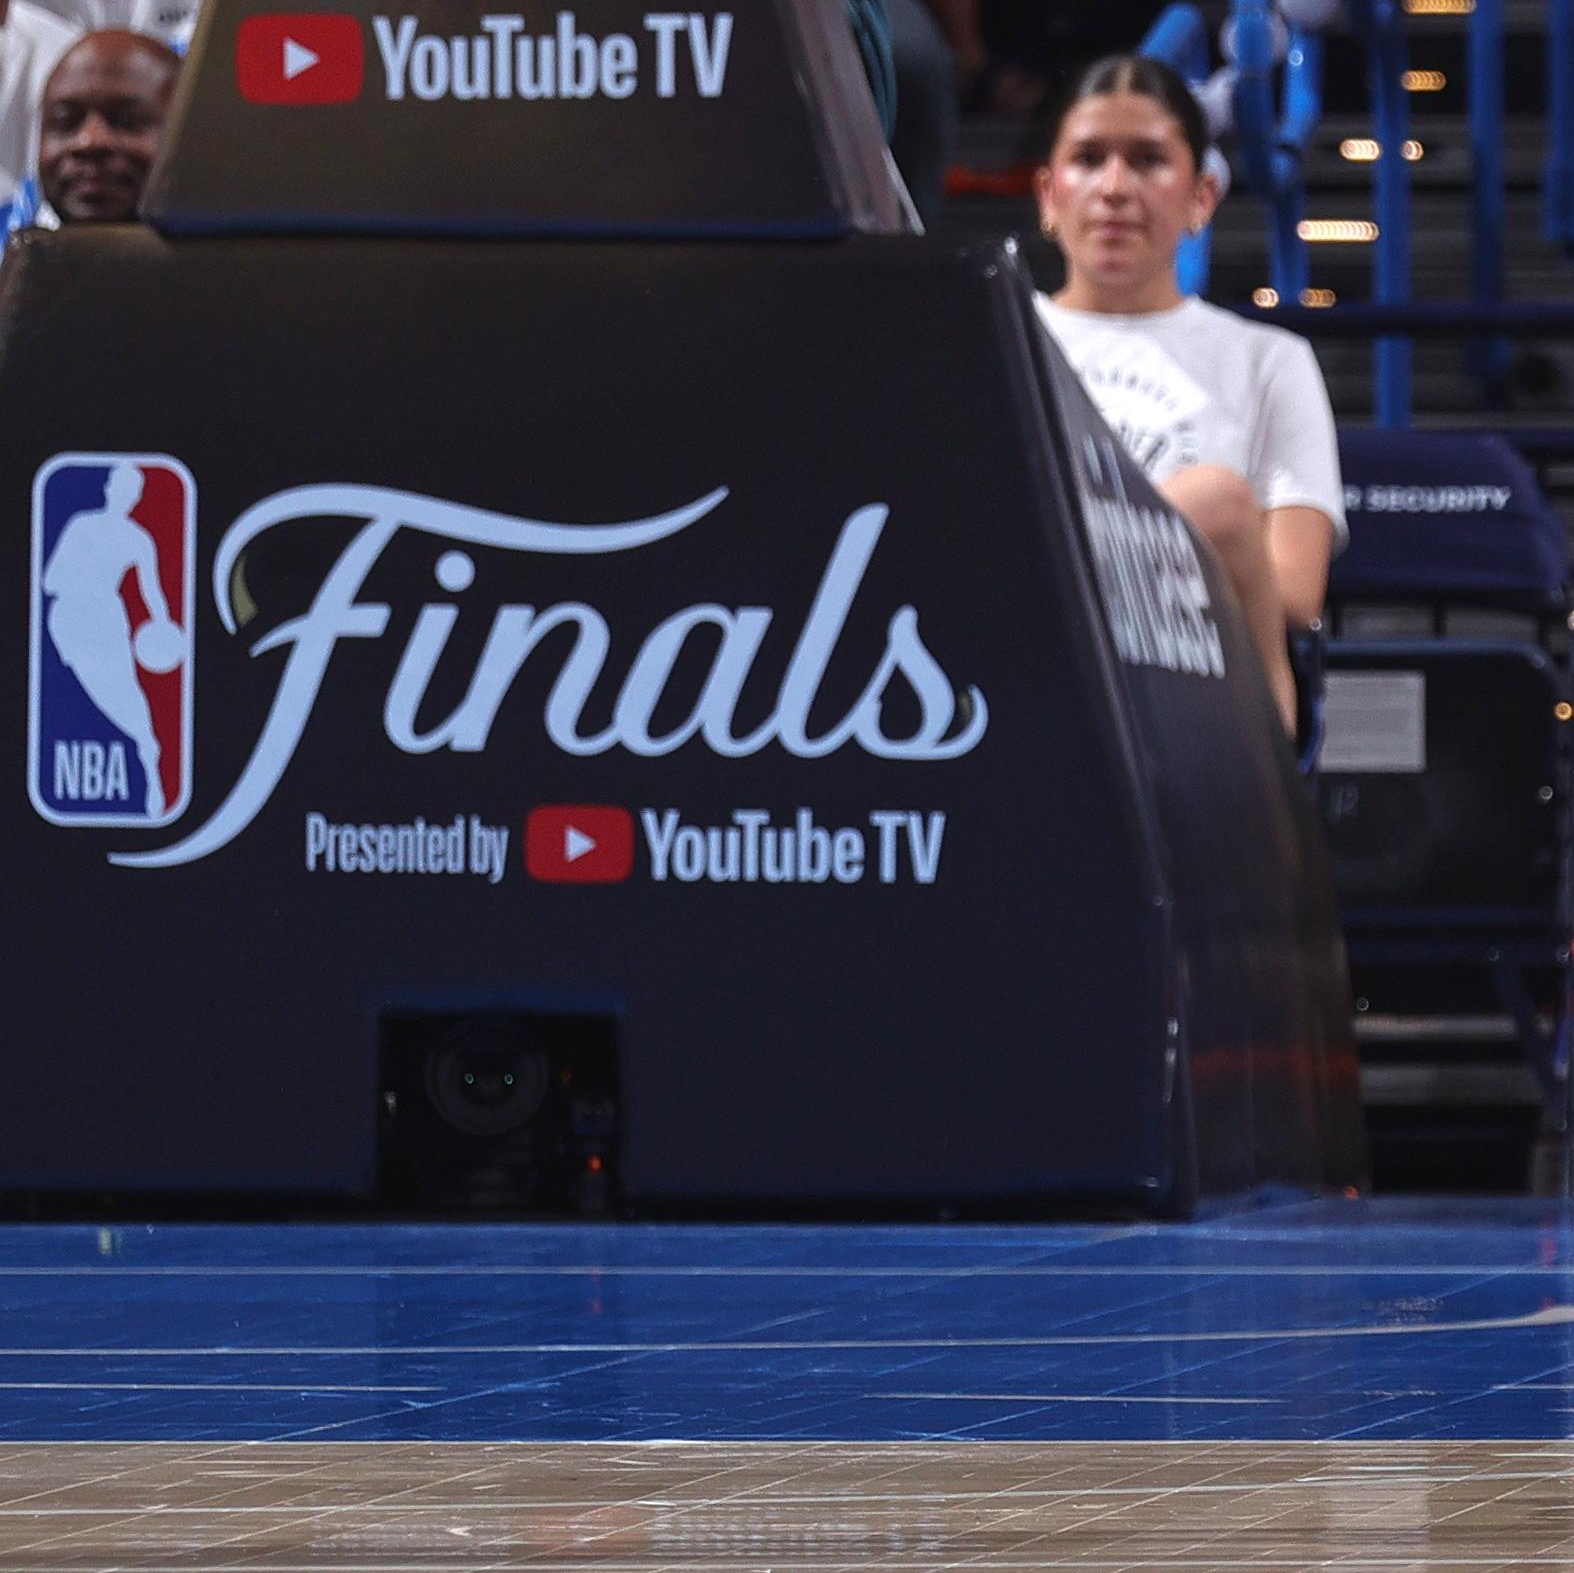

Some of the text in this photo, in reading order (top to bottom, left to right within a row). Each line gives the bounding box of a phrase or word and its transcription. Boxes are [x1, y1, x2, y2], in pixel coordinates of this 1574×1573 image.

[373, 12, 733, 101] YouTube TV
[1365, 483, 1512, 513] SECURITY
[108, 482, 989, 869] Finals
[54, 741, 129, 800] NBA
[306, 808, 946, 884] Presented by YouTube TV
